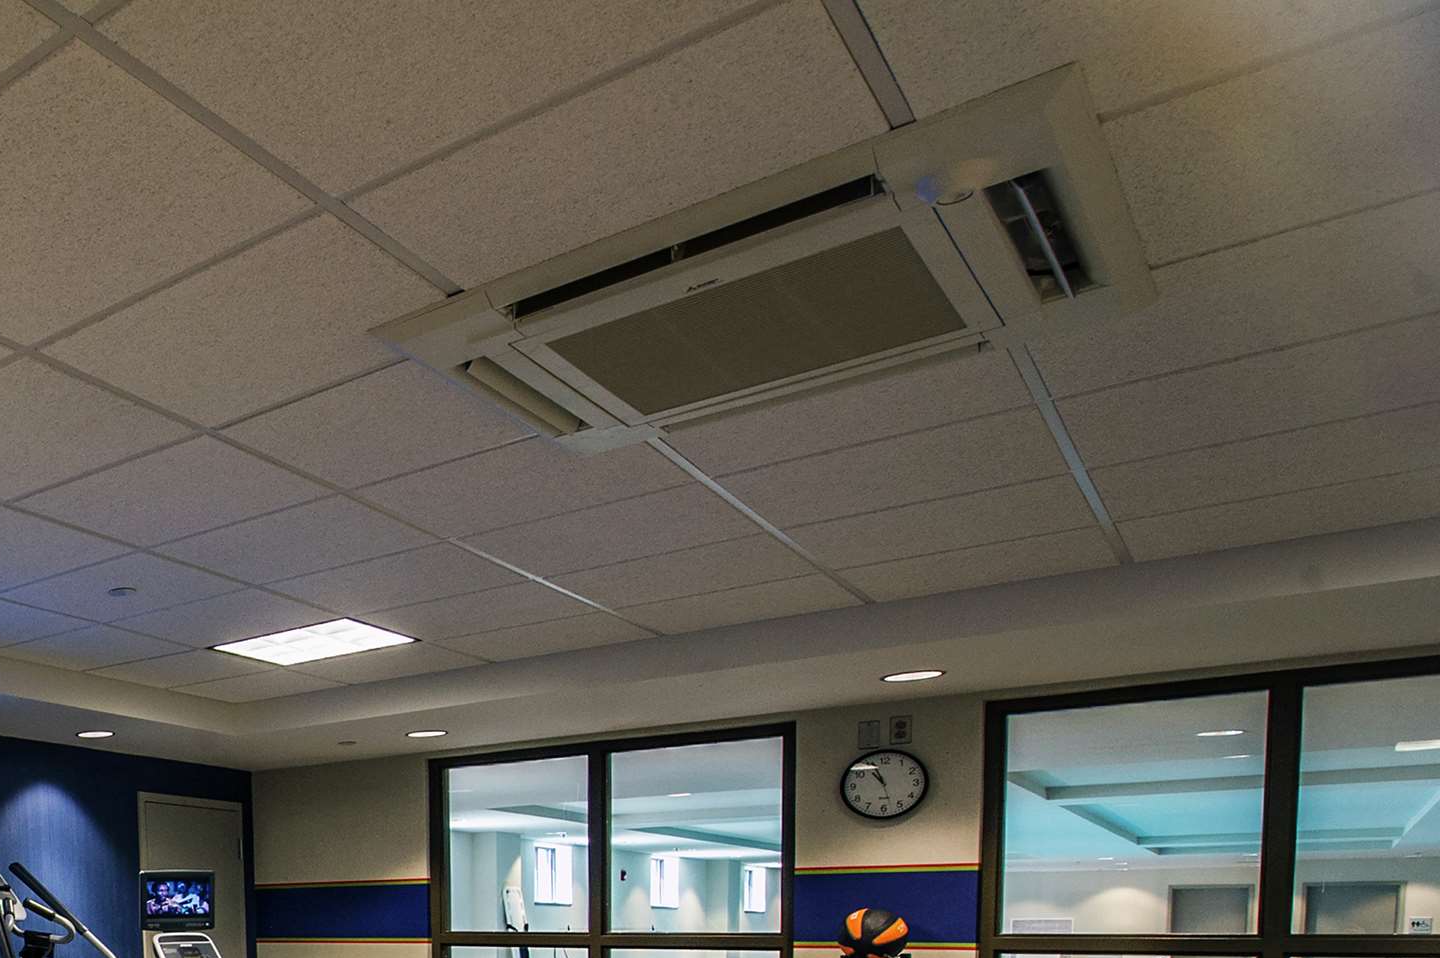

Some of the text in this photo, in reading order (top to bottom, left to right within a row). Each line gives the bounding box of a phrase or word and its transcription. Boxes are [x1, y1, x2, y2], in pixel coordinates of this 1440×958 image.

[881, 757, 890, 765] 12
[855, 770, 865, 779] 10
[909, 767, 917, 775] 2
[913, 778, 920, 786] 3
[865, 802, 872, 810] 7
[896, 800, 903, 808] 5
